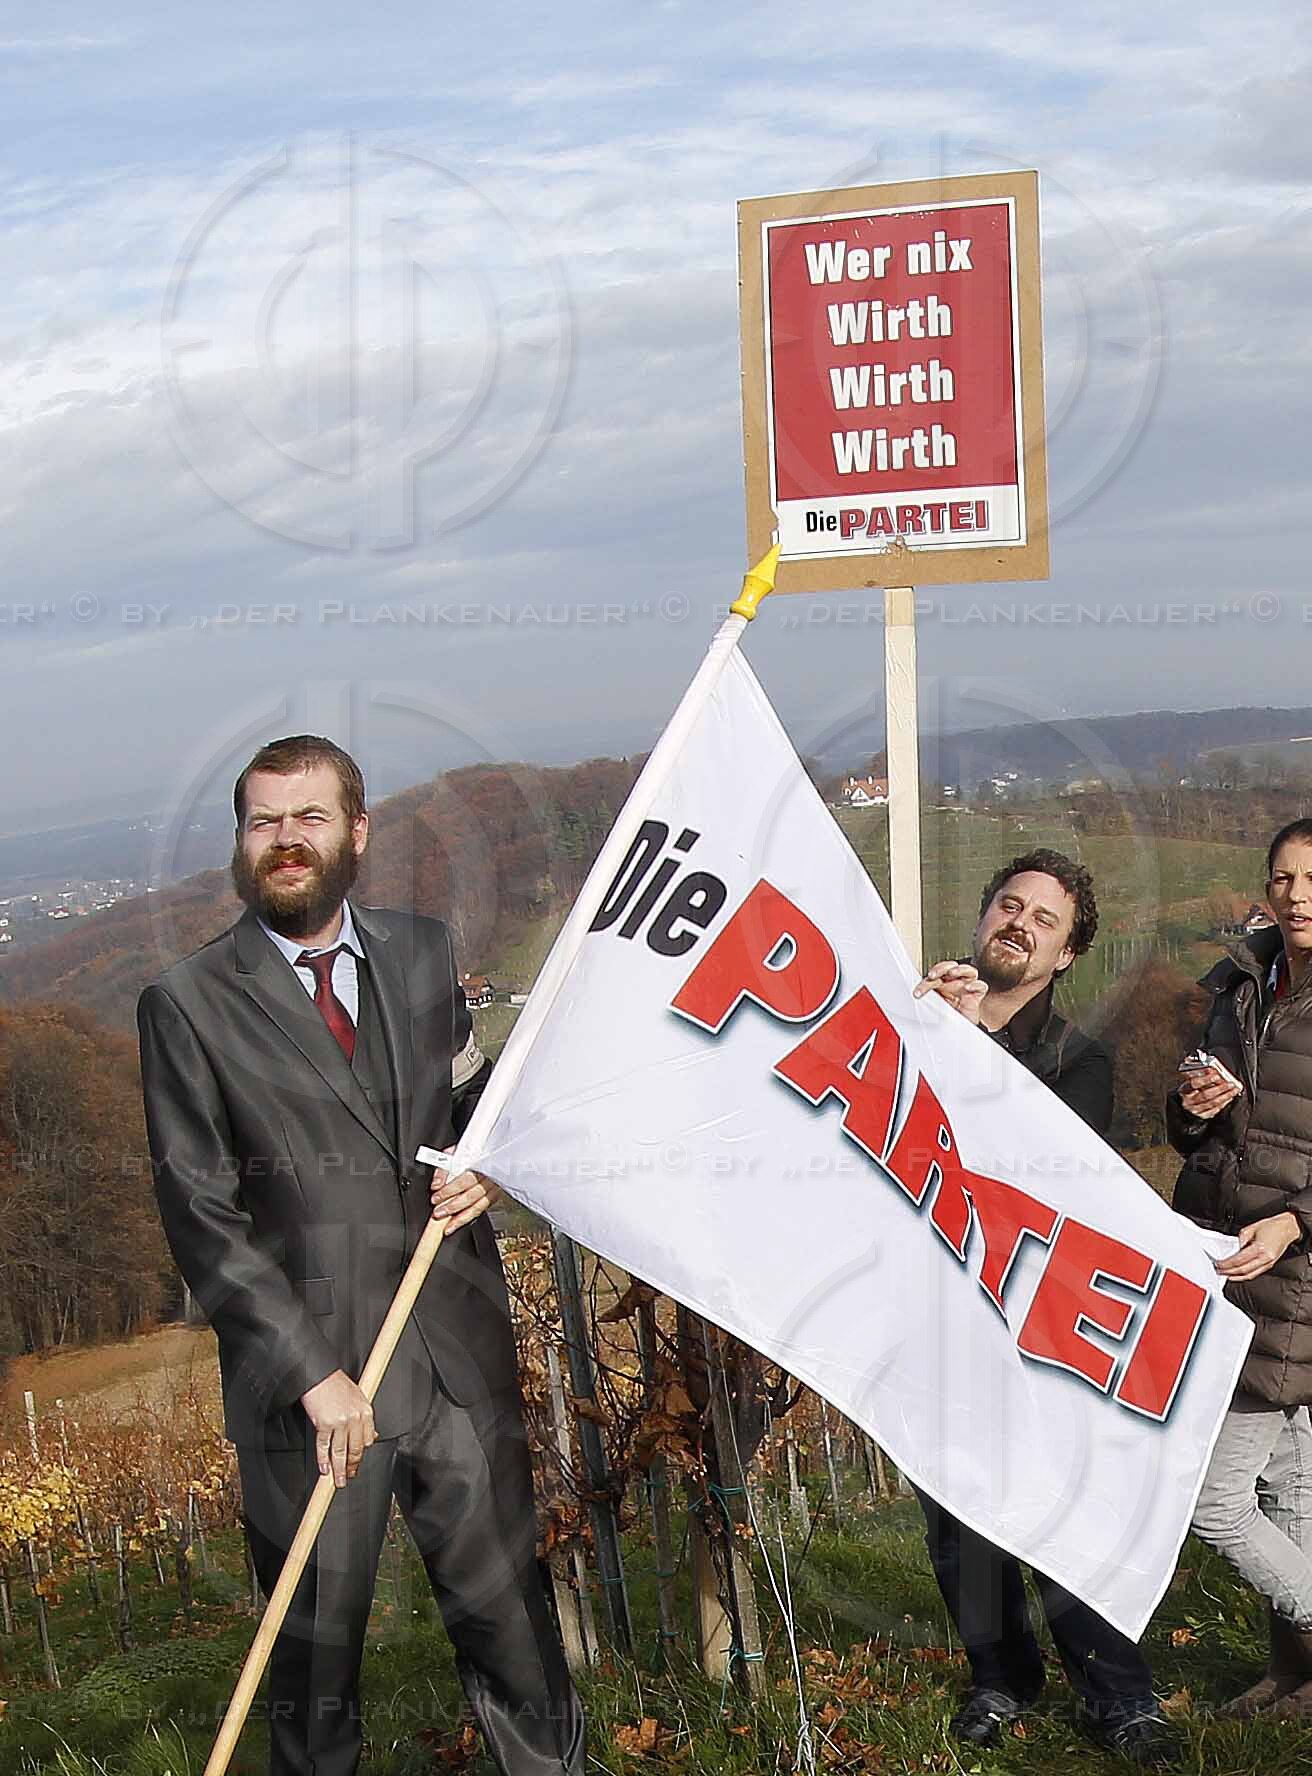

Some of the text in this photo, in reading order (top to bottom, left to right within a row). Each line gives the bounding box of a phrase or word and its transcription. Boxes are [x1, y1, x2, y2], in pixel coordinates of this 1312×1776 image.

[805, 231, 974, 285] Wer nix
[827, 295, 953, 346] Wirth
[829, 359, 955, 411] Wirth
[832, 423, 958, 475] Wirth
[589, 818, 1215, 1424] Die PARTEI
